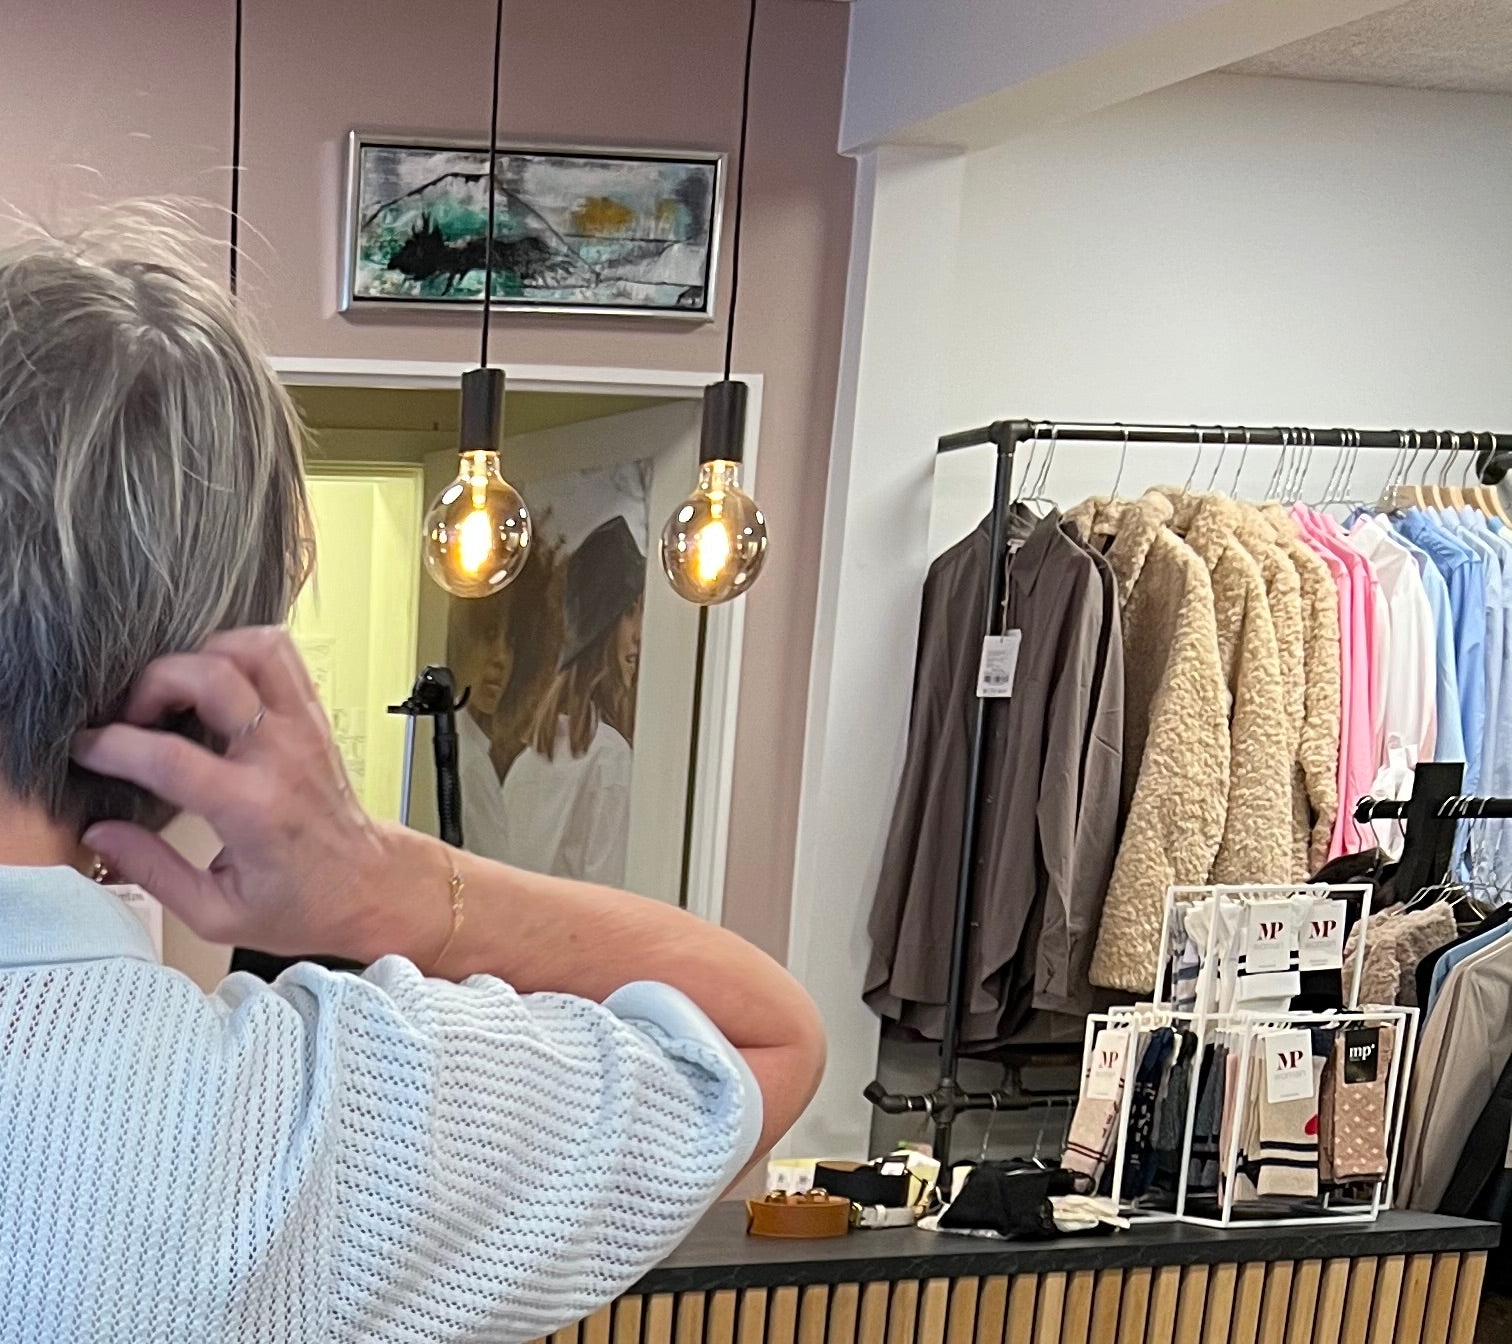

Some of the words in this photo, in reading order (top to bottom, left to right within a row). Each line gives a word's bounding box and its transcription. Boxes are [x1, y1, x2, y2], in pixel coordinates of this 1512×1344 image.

[1258, 921, 1284, 941] MP
[1309, 920, 1337, 939] MP
[1277, 1050, 1304, 1071] MP
